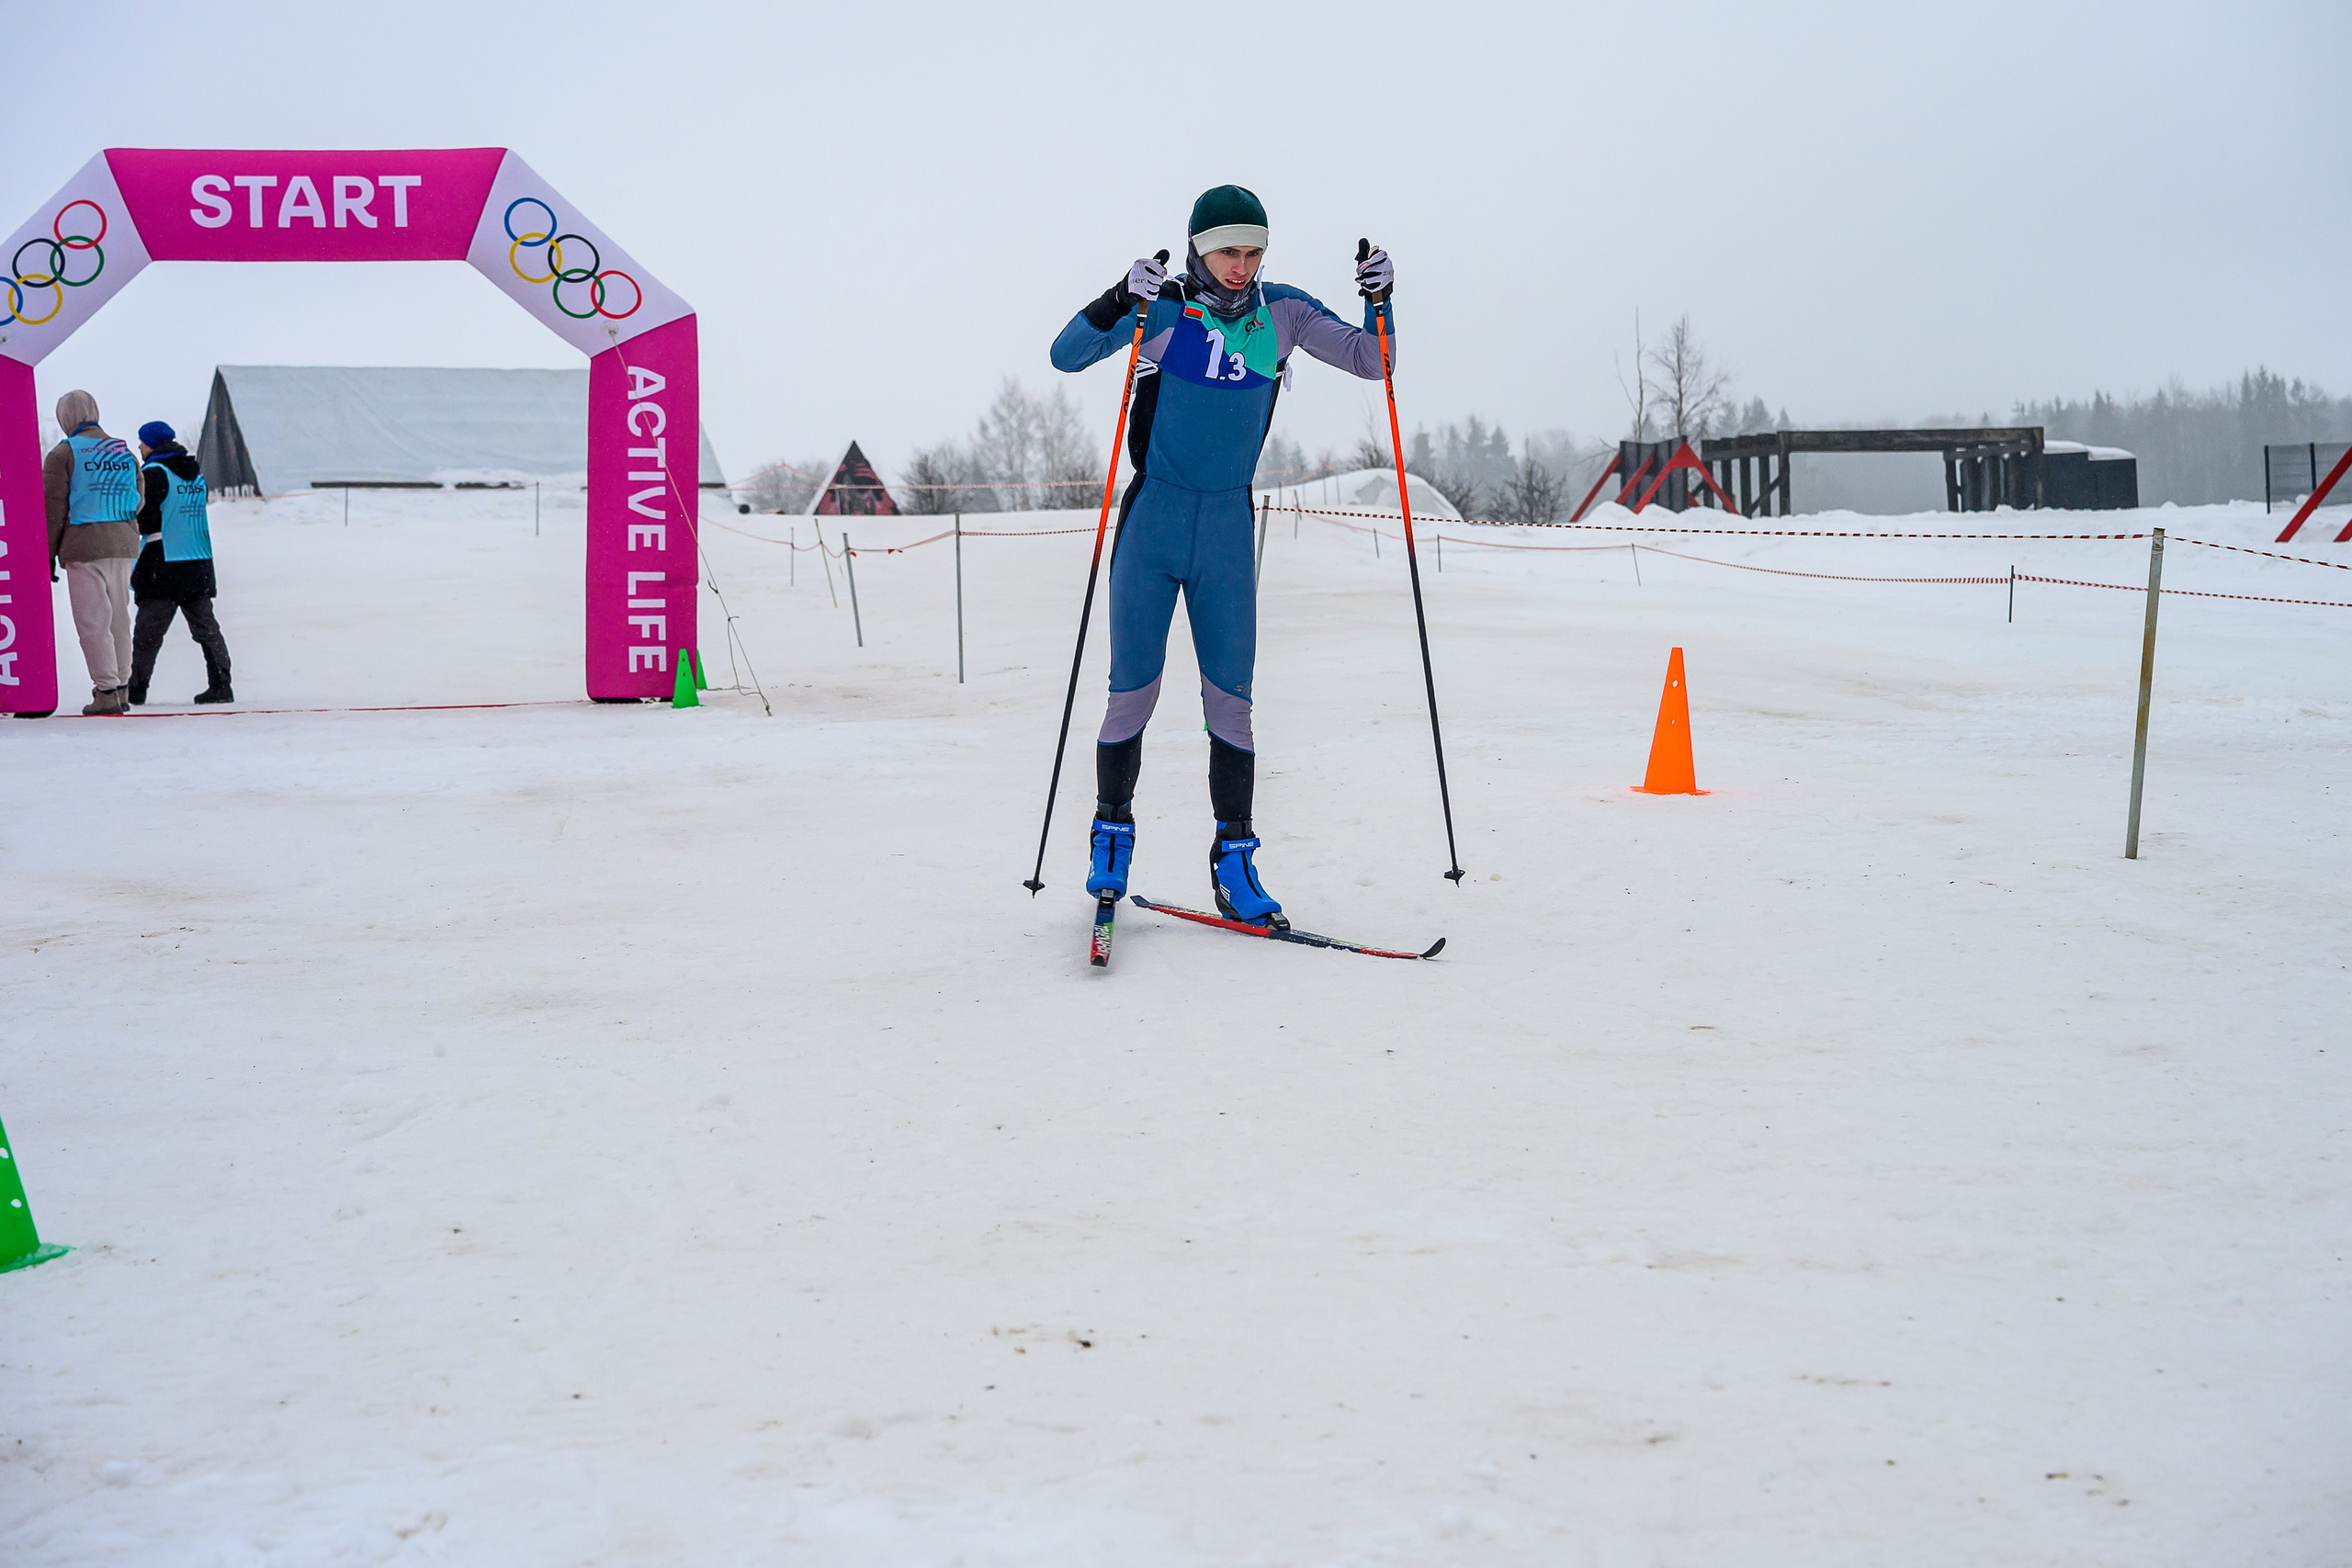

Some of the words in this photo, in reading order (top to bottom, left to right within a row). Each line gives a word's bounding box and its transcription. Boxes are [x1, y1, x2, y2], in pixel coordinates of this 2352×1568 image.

[190, 175, 422, 228] START
[1204, 328, 1247, 381] 1.3
[84, 461, 130, 472] СУДЬЯ
[628, 366, 666, 551] ACTIVE
[628, 571, 667, 673] LIFE
[1102, 824, 1129, 832] SPINE
[1228, 840, 1254, 850] SPINE
